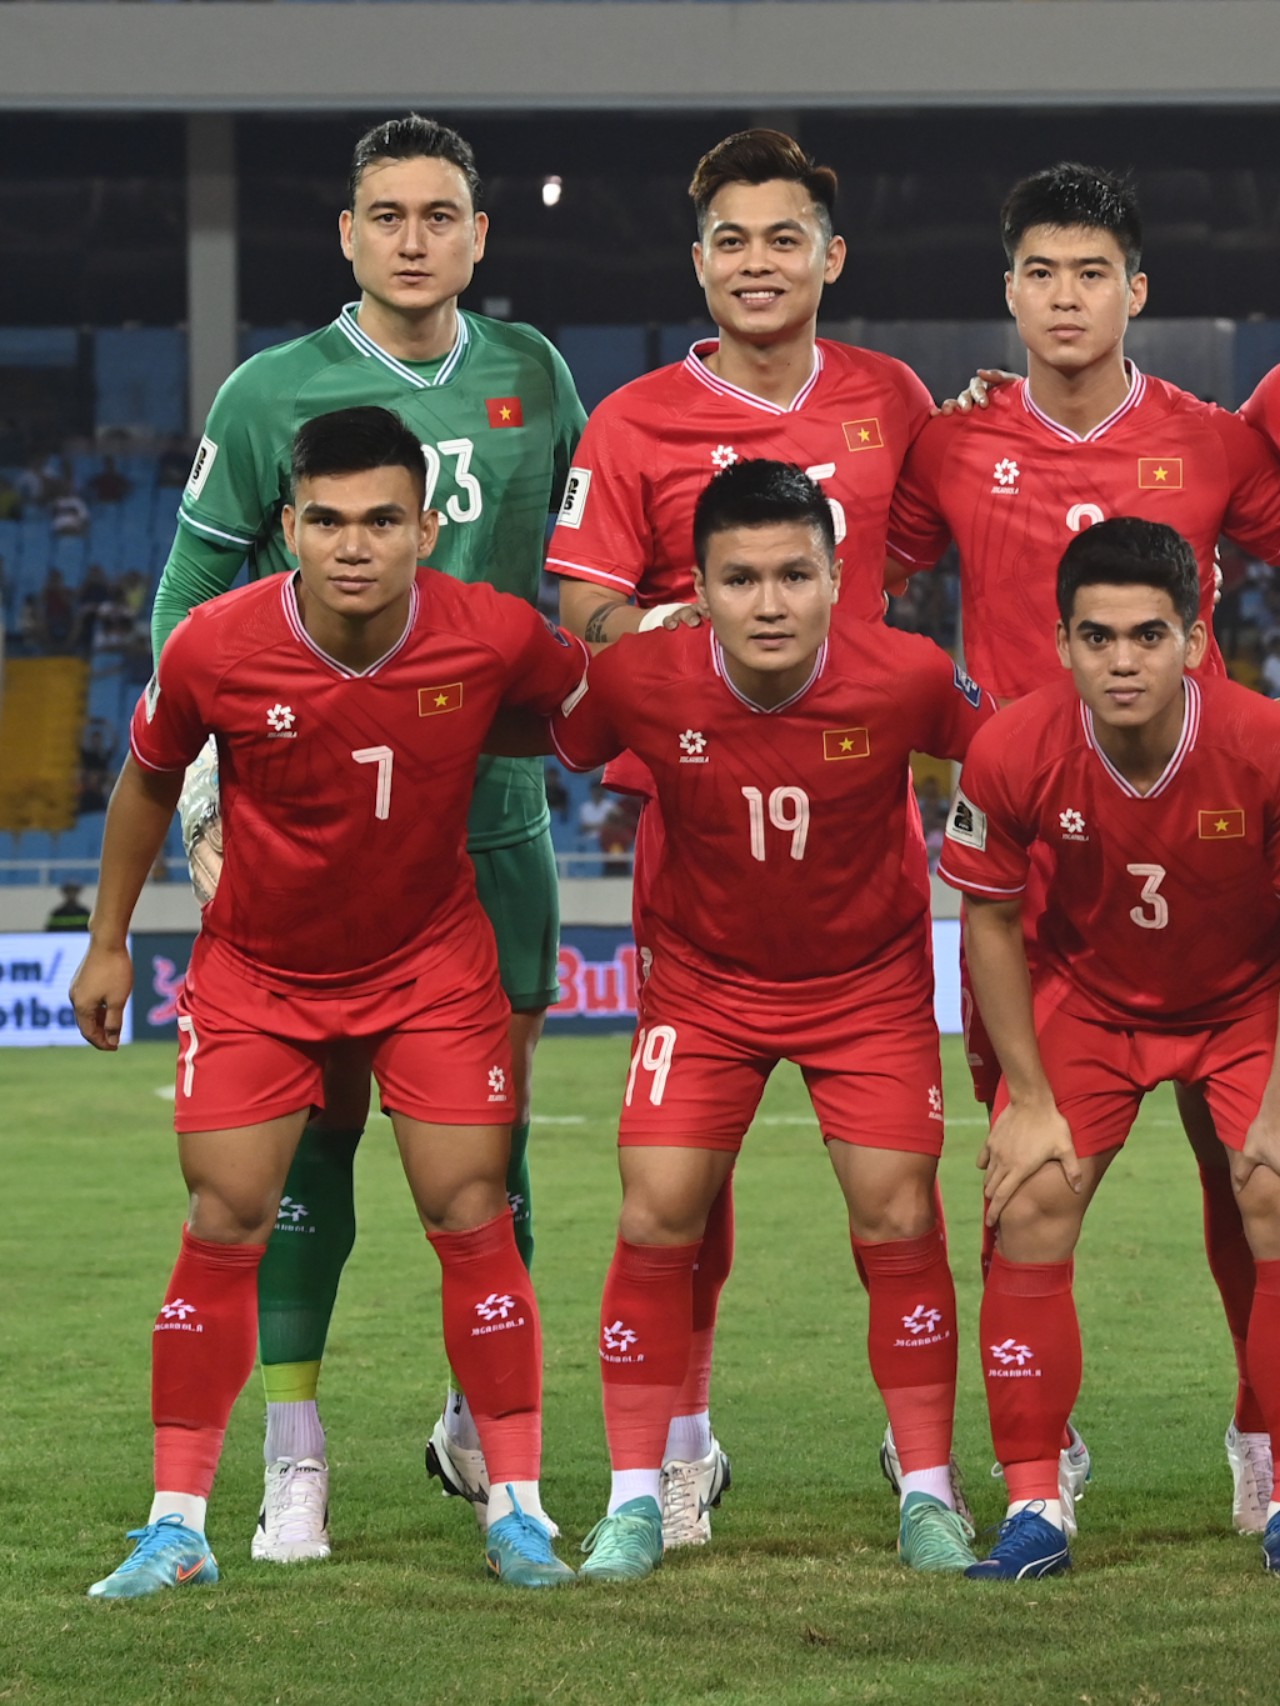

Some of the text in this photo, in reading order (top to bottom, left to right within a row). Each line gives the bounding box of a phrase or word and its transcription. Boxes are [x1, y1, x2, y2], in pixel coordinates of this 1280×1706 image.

[351, 744, 394, 820] 7
[741, 785, 811, 862] 19
[1126, 863, 1170, 930] 3
[177, 1015, 199, 1098] 7
[625, 1024, 678, 1107] 19
